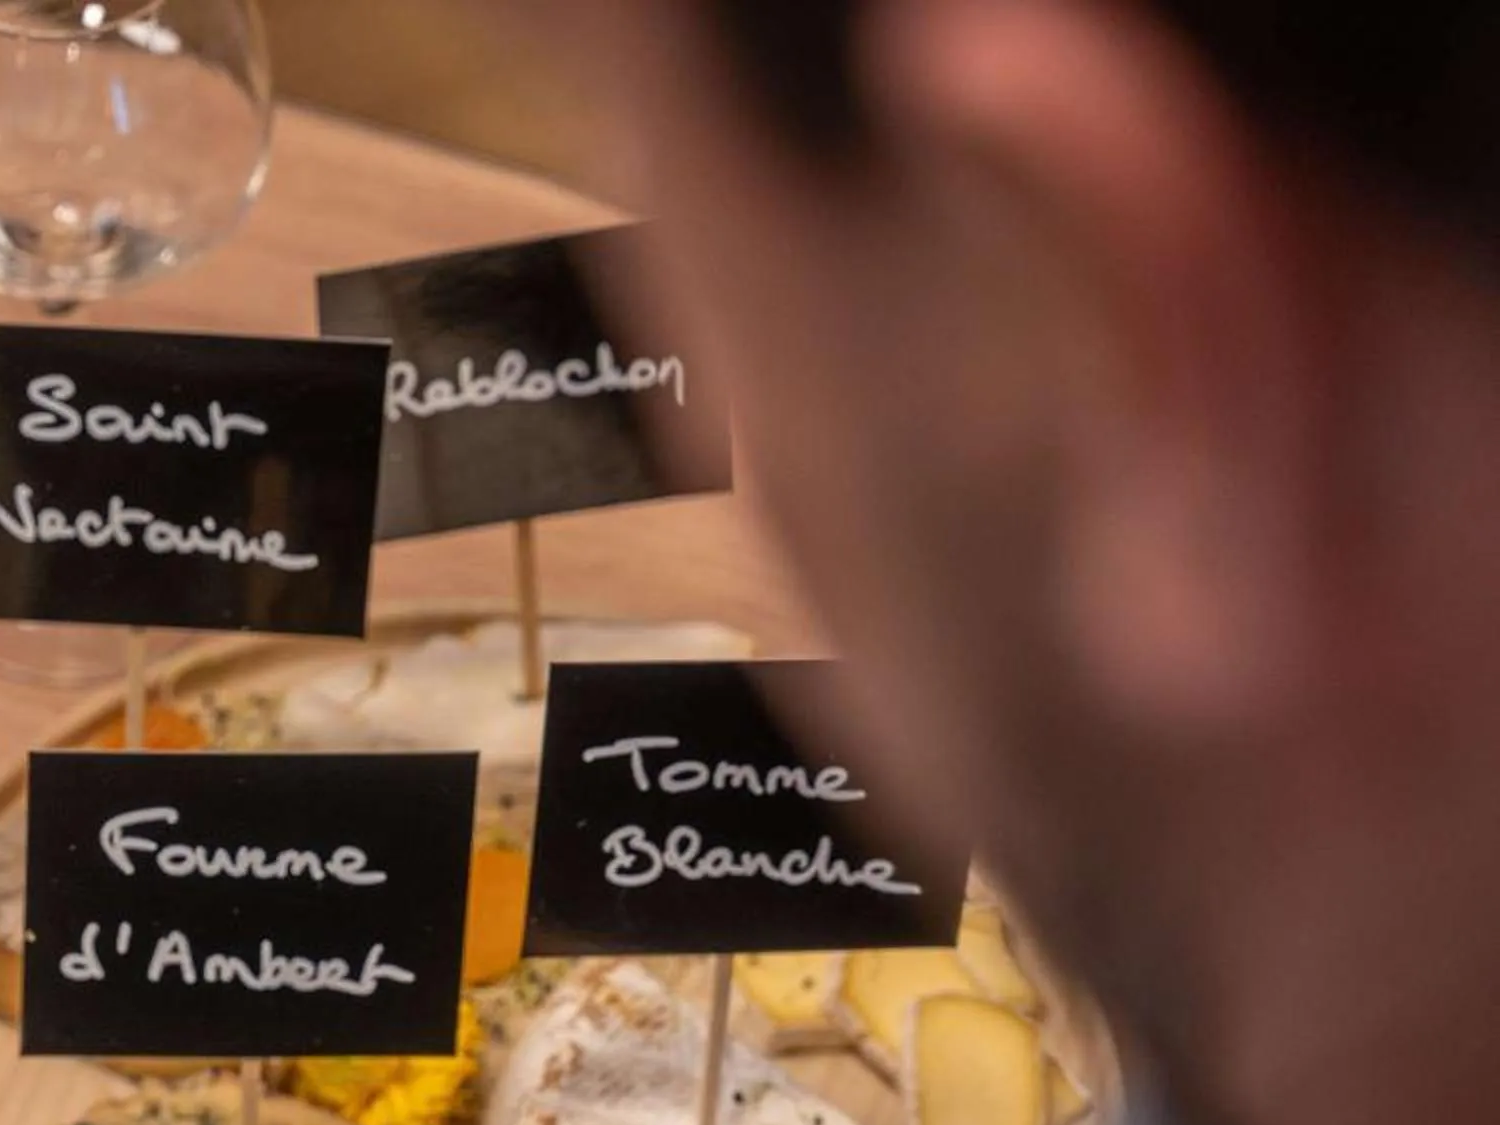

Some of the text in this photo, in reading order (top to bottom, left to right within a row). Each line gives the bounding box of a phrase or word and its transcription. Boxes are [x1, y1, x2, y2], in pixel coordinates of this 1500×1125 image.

[19, 374, 267, 450] Saint
[385, 341, 686, 422] Reblochon
[583, 736, 868, 800] Tomme
[99, 807, 387, 885] Fourme
[602, 825, 922, 895] Blanche
[59, 921, 416, 996] d'Ambert
